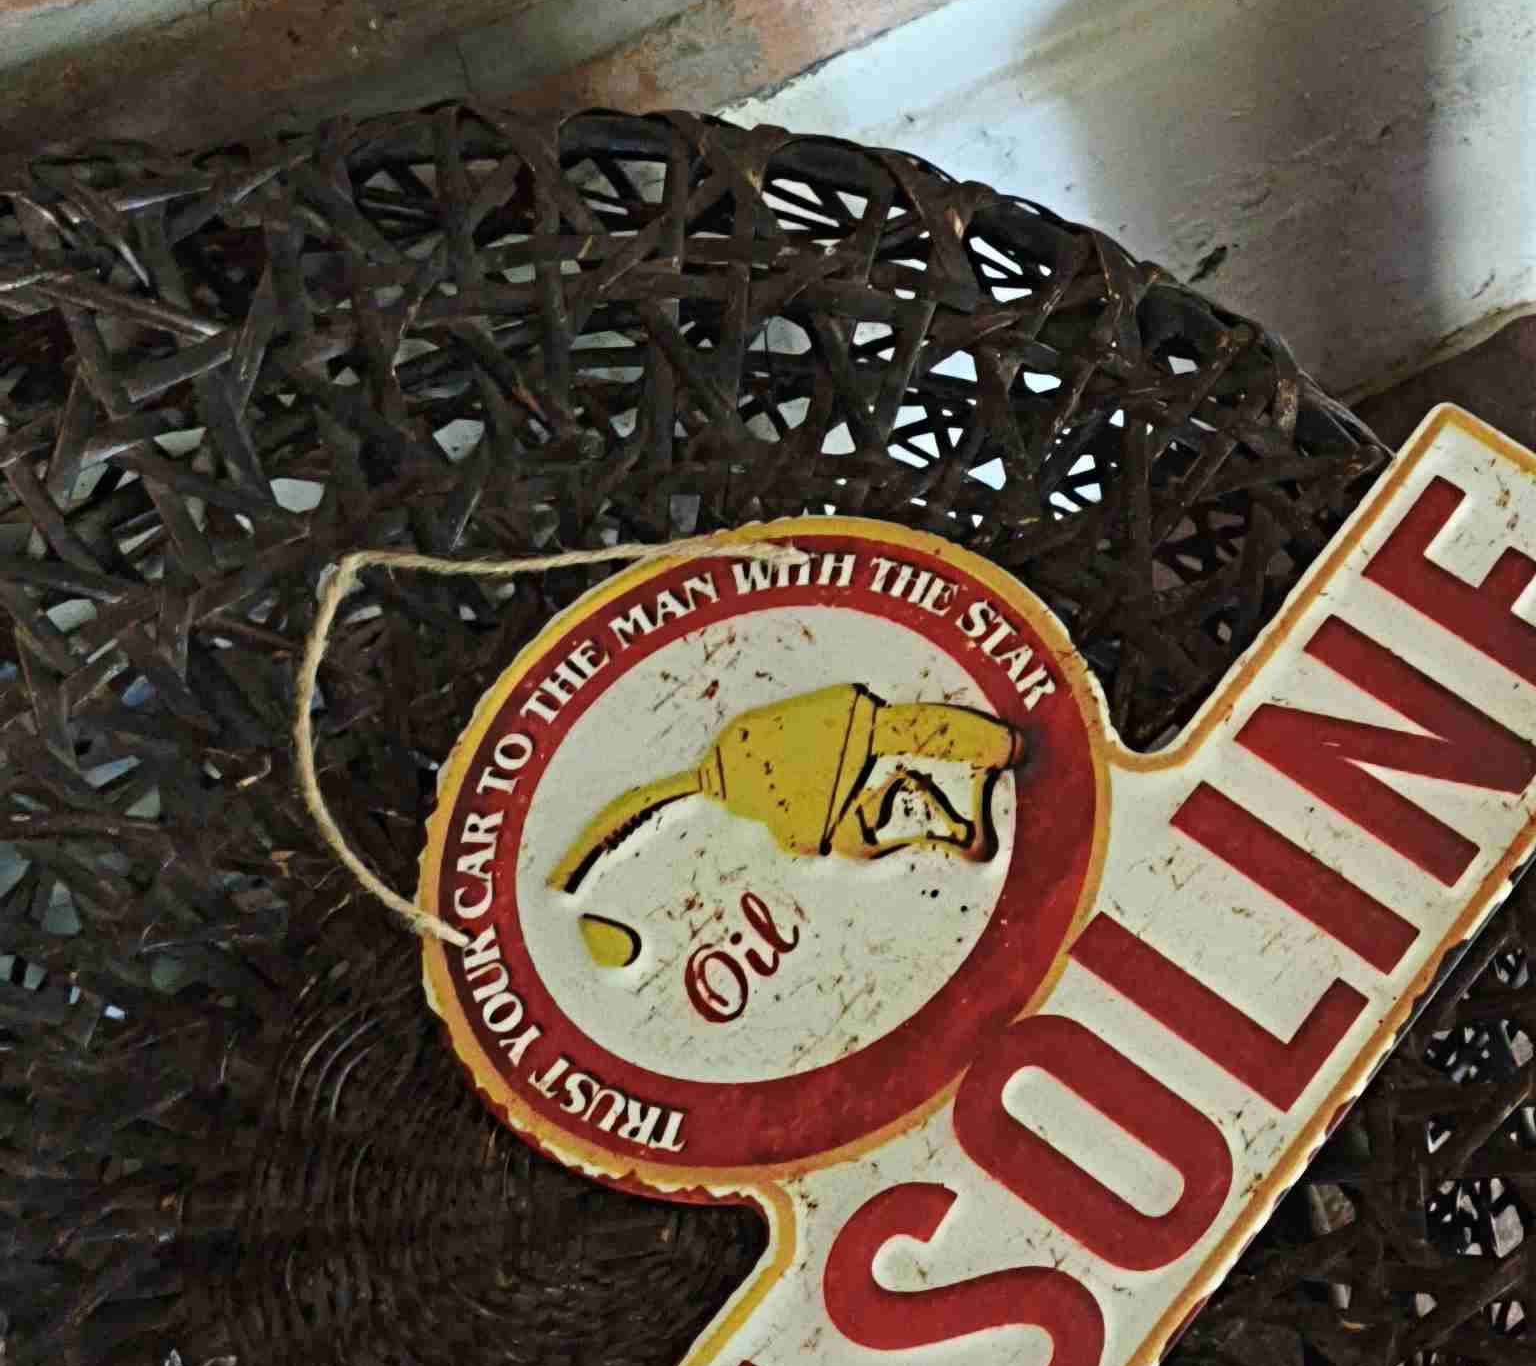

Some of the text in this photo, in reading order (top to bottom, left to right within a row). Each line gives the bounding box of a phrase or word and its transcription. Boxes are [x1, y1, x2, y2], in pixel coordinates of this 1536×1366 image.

[453, 551, 1058, 1153] TRUST YOUR CAR TO THE MAN WITH THE STAR
[684, 891, 801, 1024] Oil
